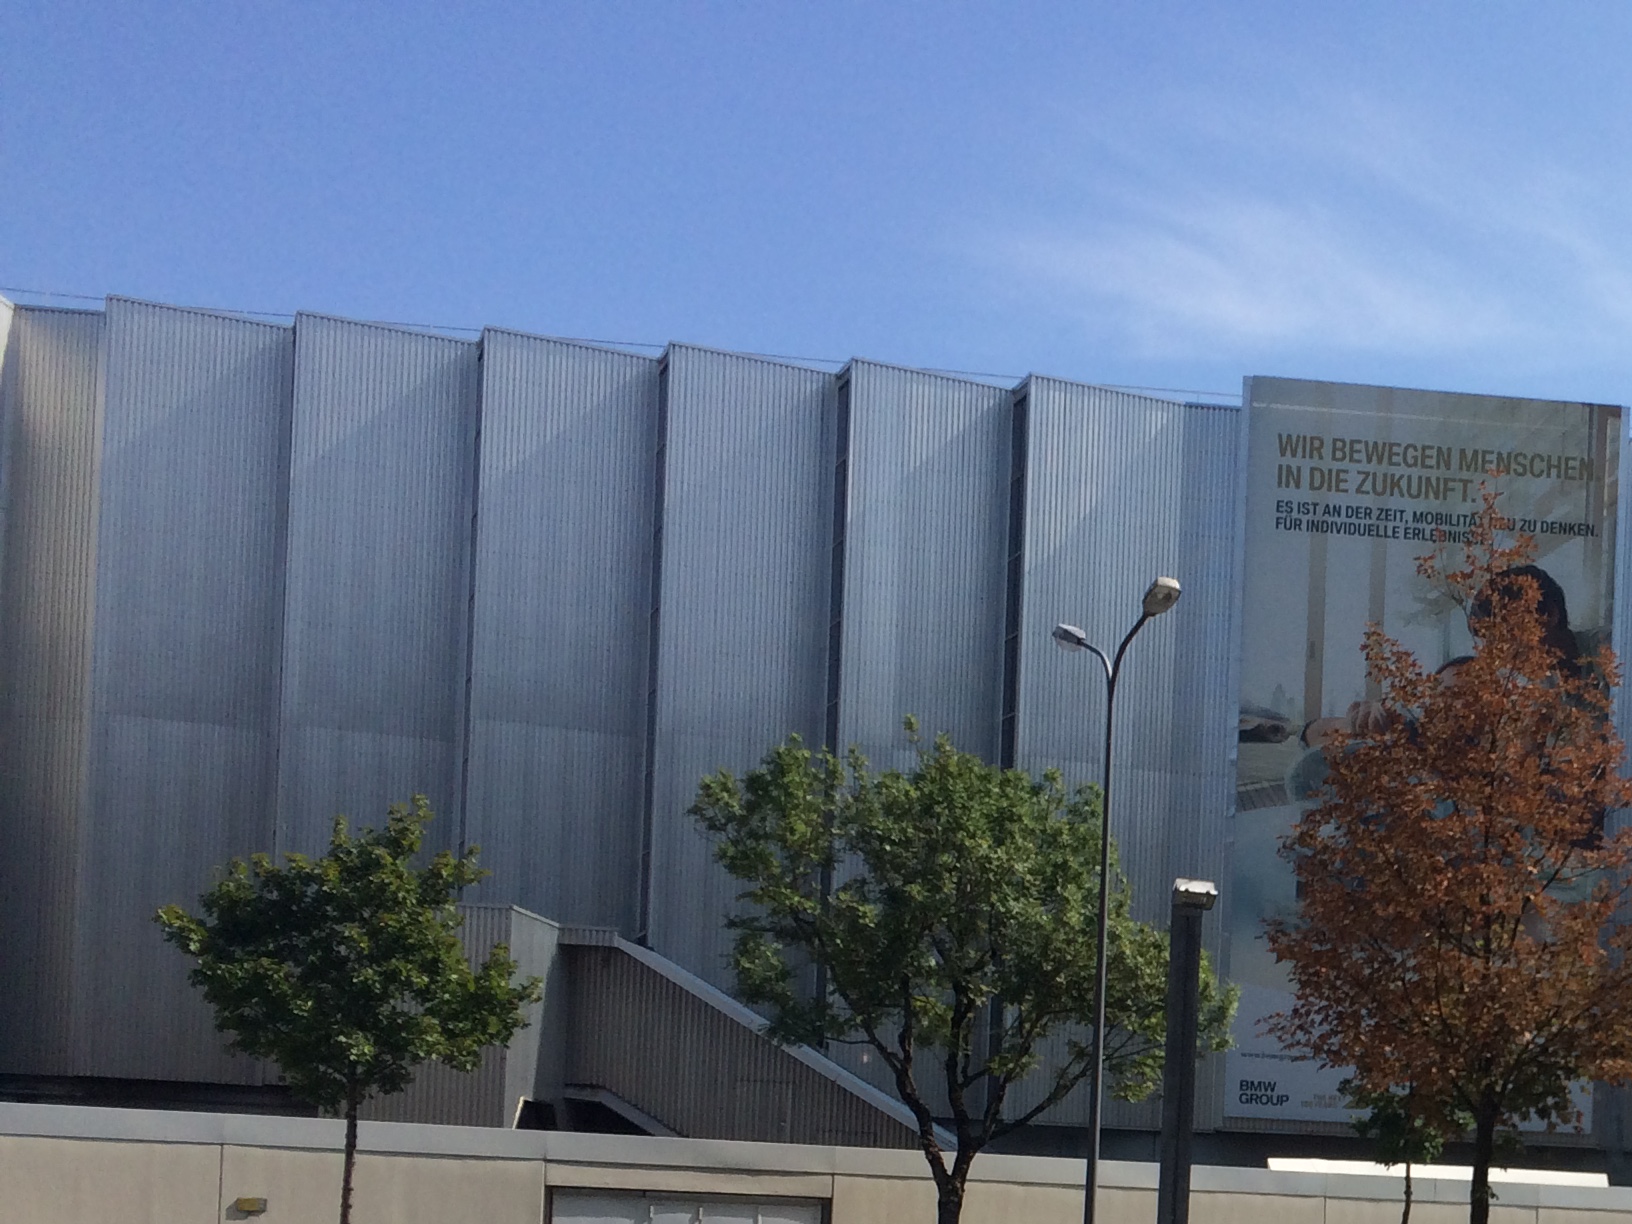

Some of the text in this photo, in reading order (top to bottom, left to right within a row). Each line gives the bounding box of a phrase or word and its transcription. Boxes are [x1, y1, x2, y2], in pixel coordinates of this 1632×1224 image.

[1277, 432, 1594, 482] WIR BEWEGEN MENSCHEN
[1277, 463, 1477, 503] IN DIE ZUKUNFT.
[1275, 499, 1294, 515] ES
[1297, 501, 1319, 517] IST
[1322, 503, 1342, 519] AN
[1345, 505, 1373, 521] DER
[1376, 507, 1408, 525] ZEIT,
[1412, 511, 1484, 529] MOBILITÄ
[1519, 518, 1537, 533] ZU
[1540, 520, 1599, 538] DENKEN.
[1275, 515, 1302, 532] FÜR
[1306, 519, 1400, 540] INDIVIDUELLE
[1238, 1093, 1290, 1106] GROUP
[1239, 1079, 1277, 1093] BMW
